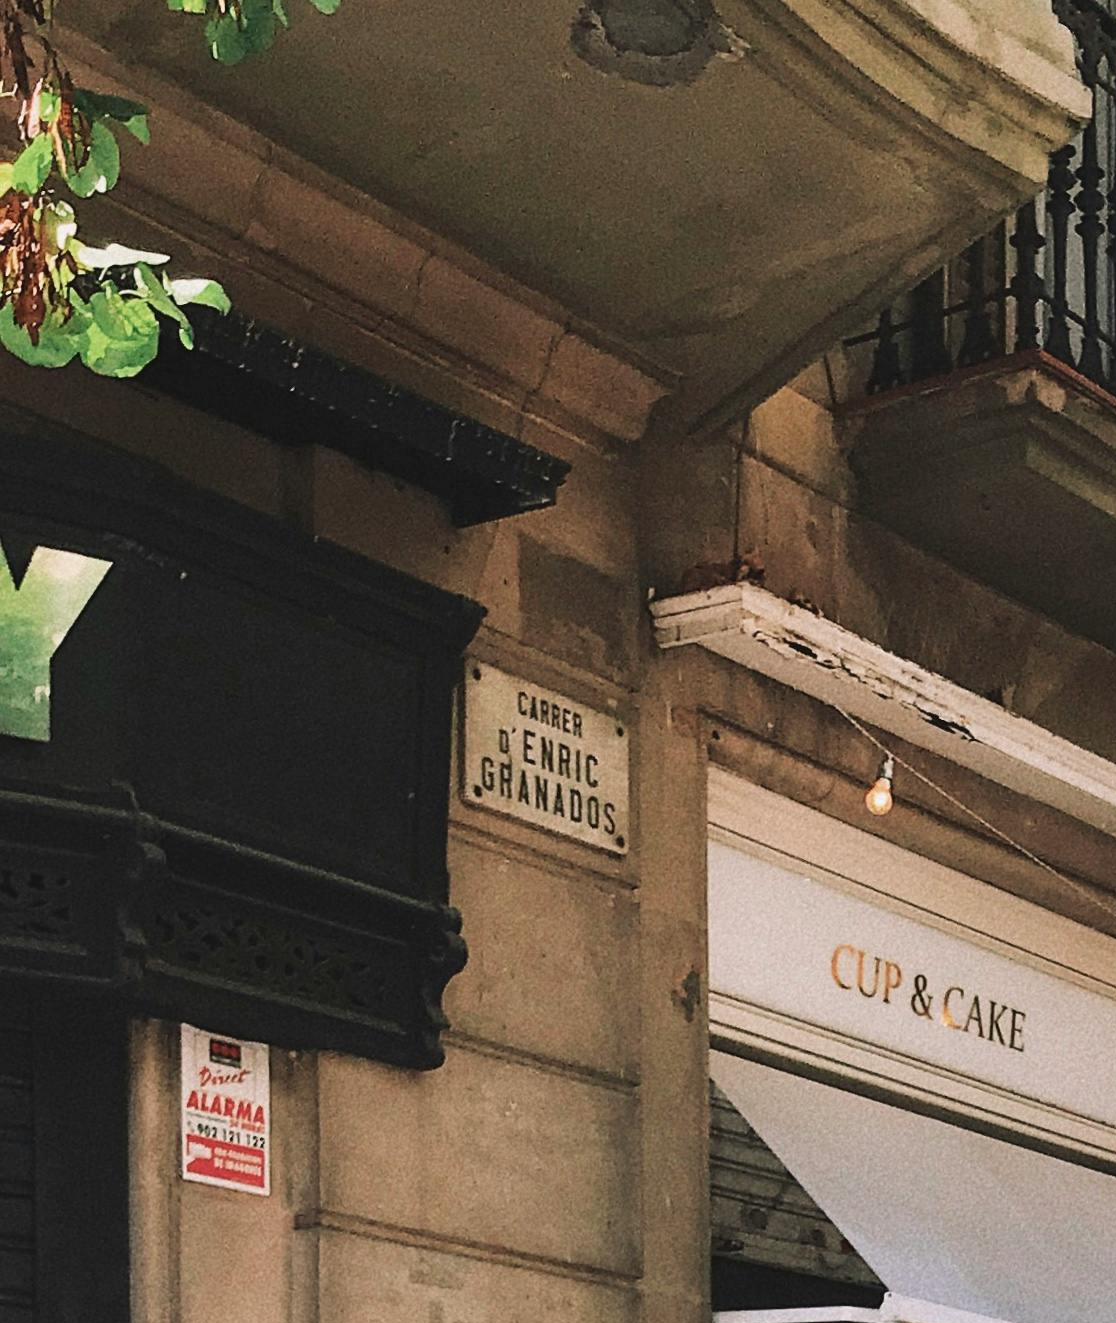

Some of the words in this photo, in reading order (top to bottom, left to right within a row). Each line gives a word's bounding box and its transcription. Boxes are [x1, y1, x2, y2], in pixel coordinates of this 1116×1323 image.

[517, 691, 583, 738] CARRER
[499, 728, 599, 788] D'ENRIC
[481, 756, 616, 835] GRANADOS
[831, 943, 903, 1004] CUP
[910, 973, 934, 1020] &
[941, 986, 1027, 1053] CAKE
[186, 1089, 265, 1124] ALARMA
